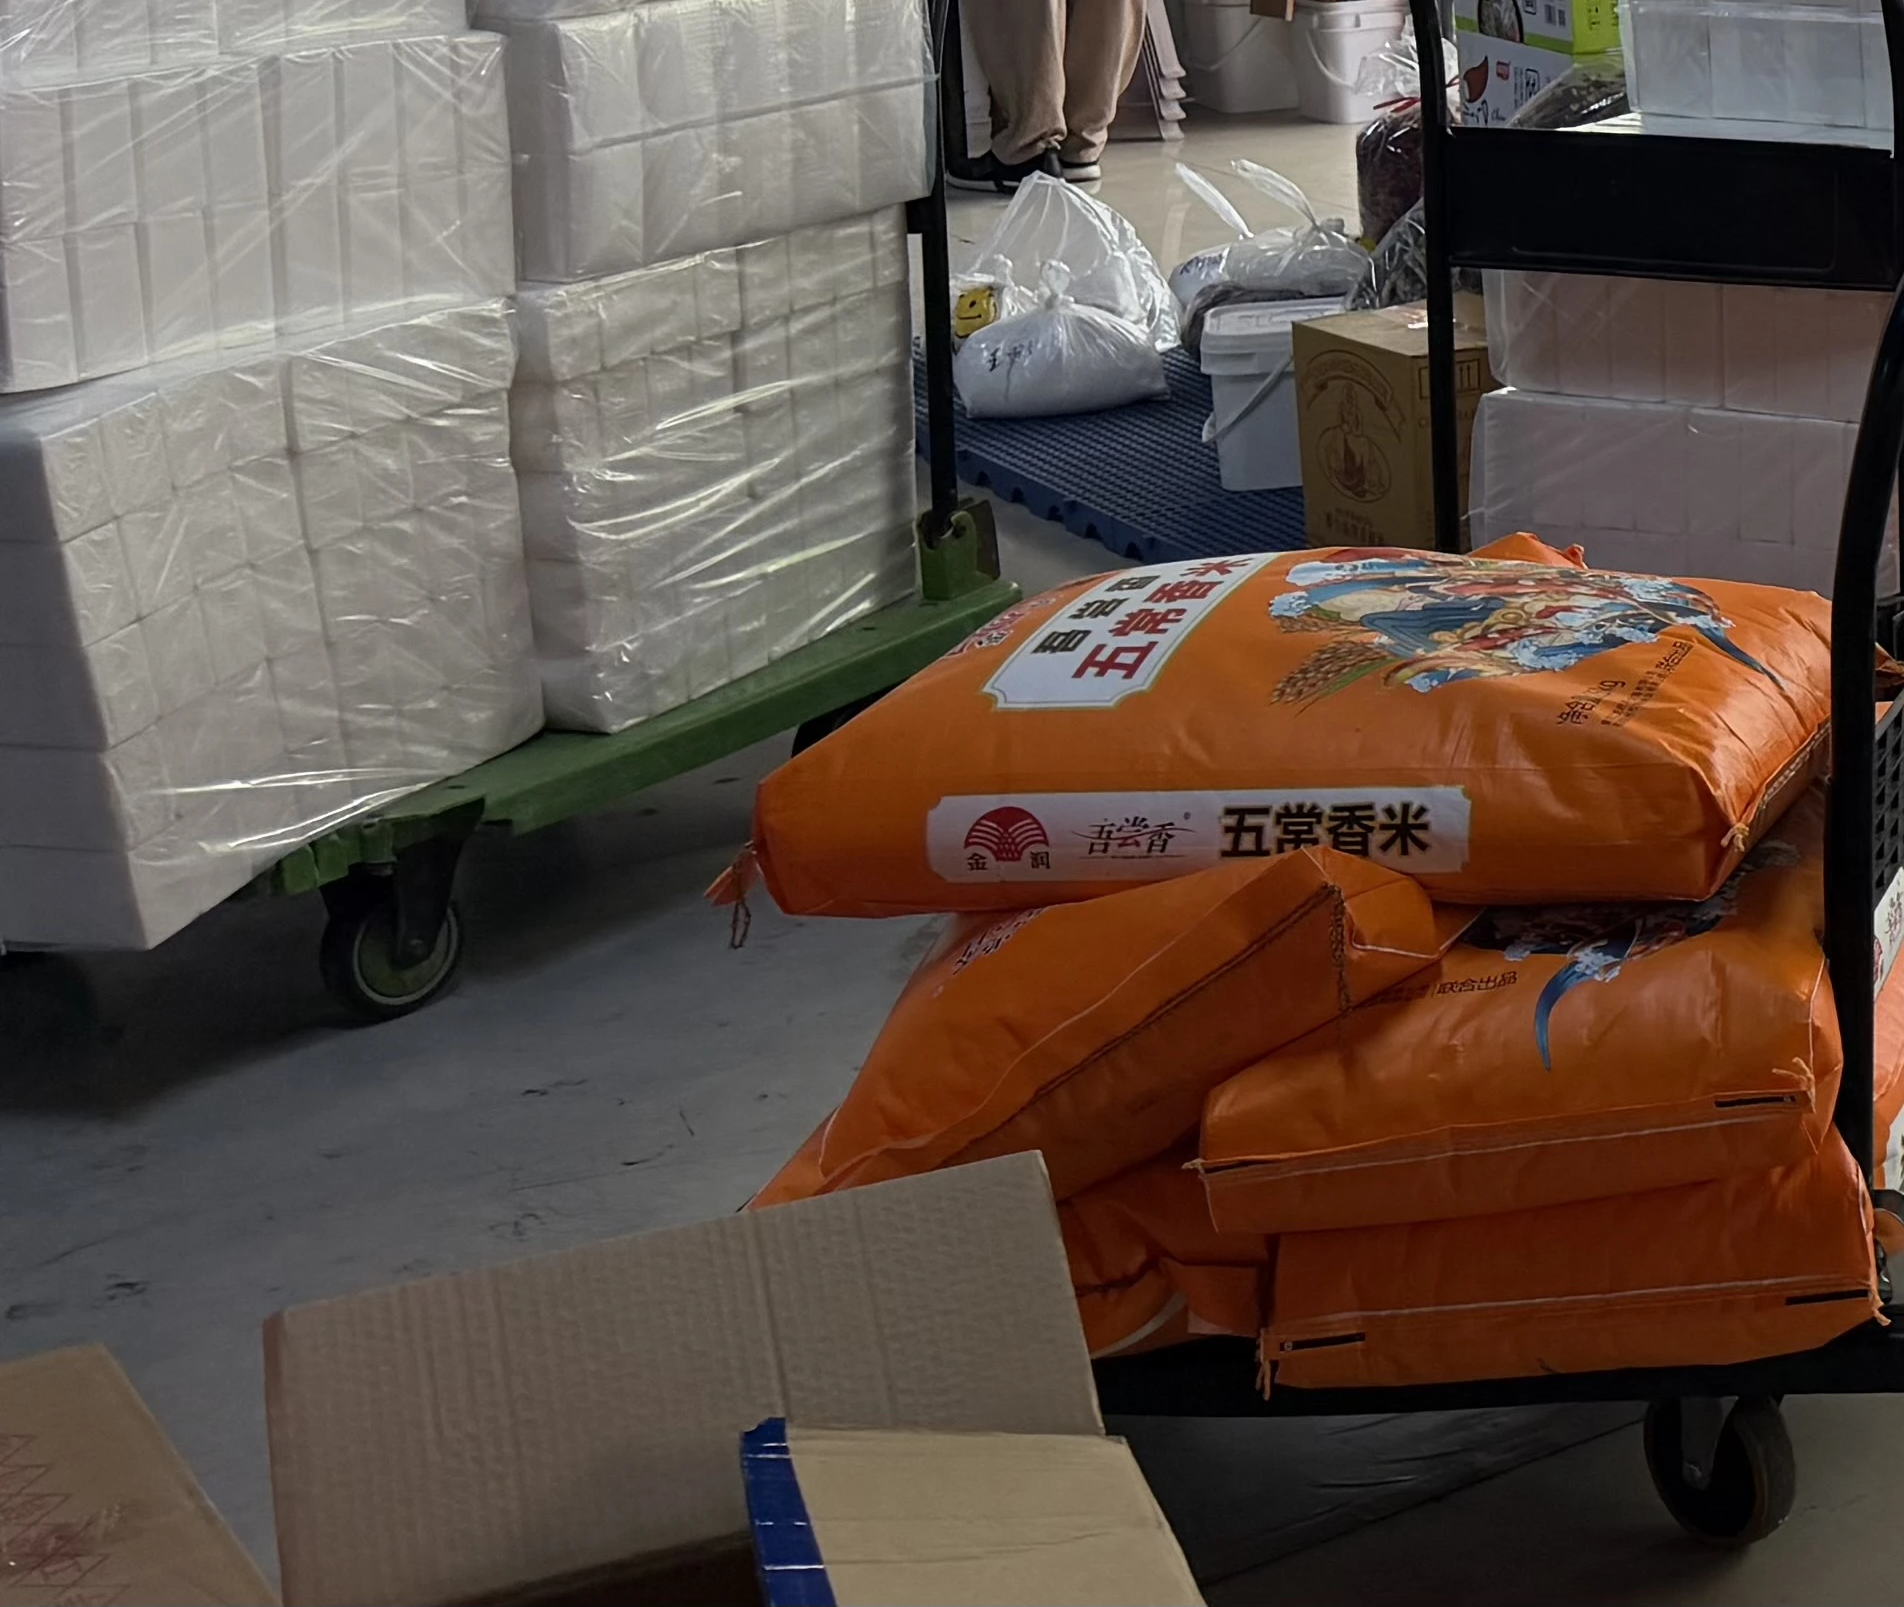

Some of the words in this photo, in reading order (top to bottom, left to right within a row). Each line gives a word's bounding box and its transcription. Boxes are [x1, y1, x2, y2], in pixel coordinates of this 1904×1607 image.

[1071, 558, 1254, 679] 五常香米
[1221, 802, 1432, 859] 五常香米
